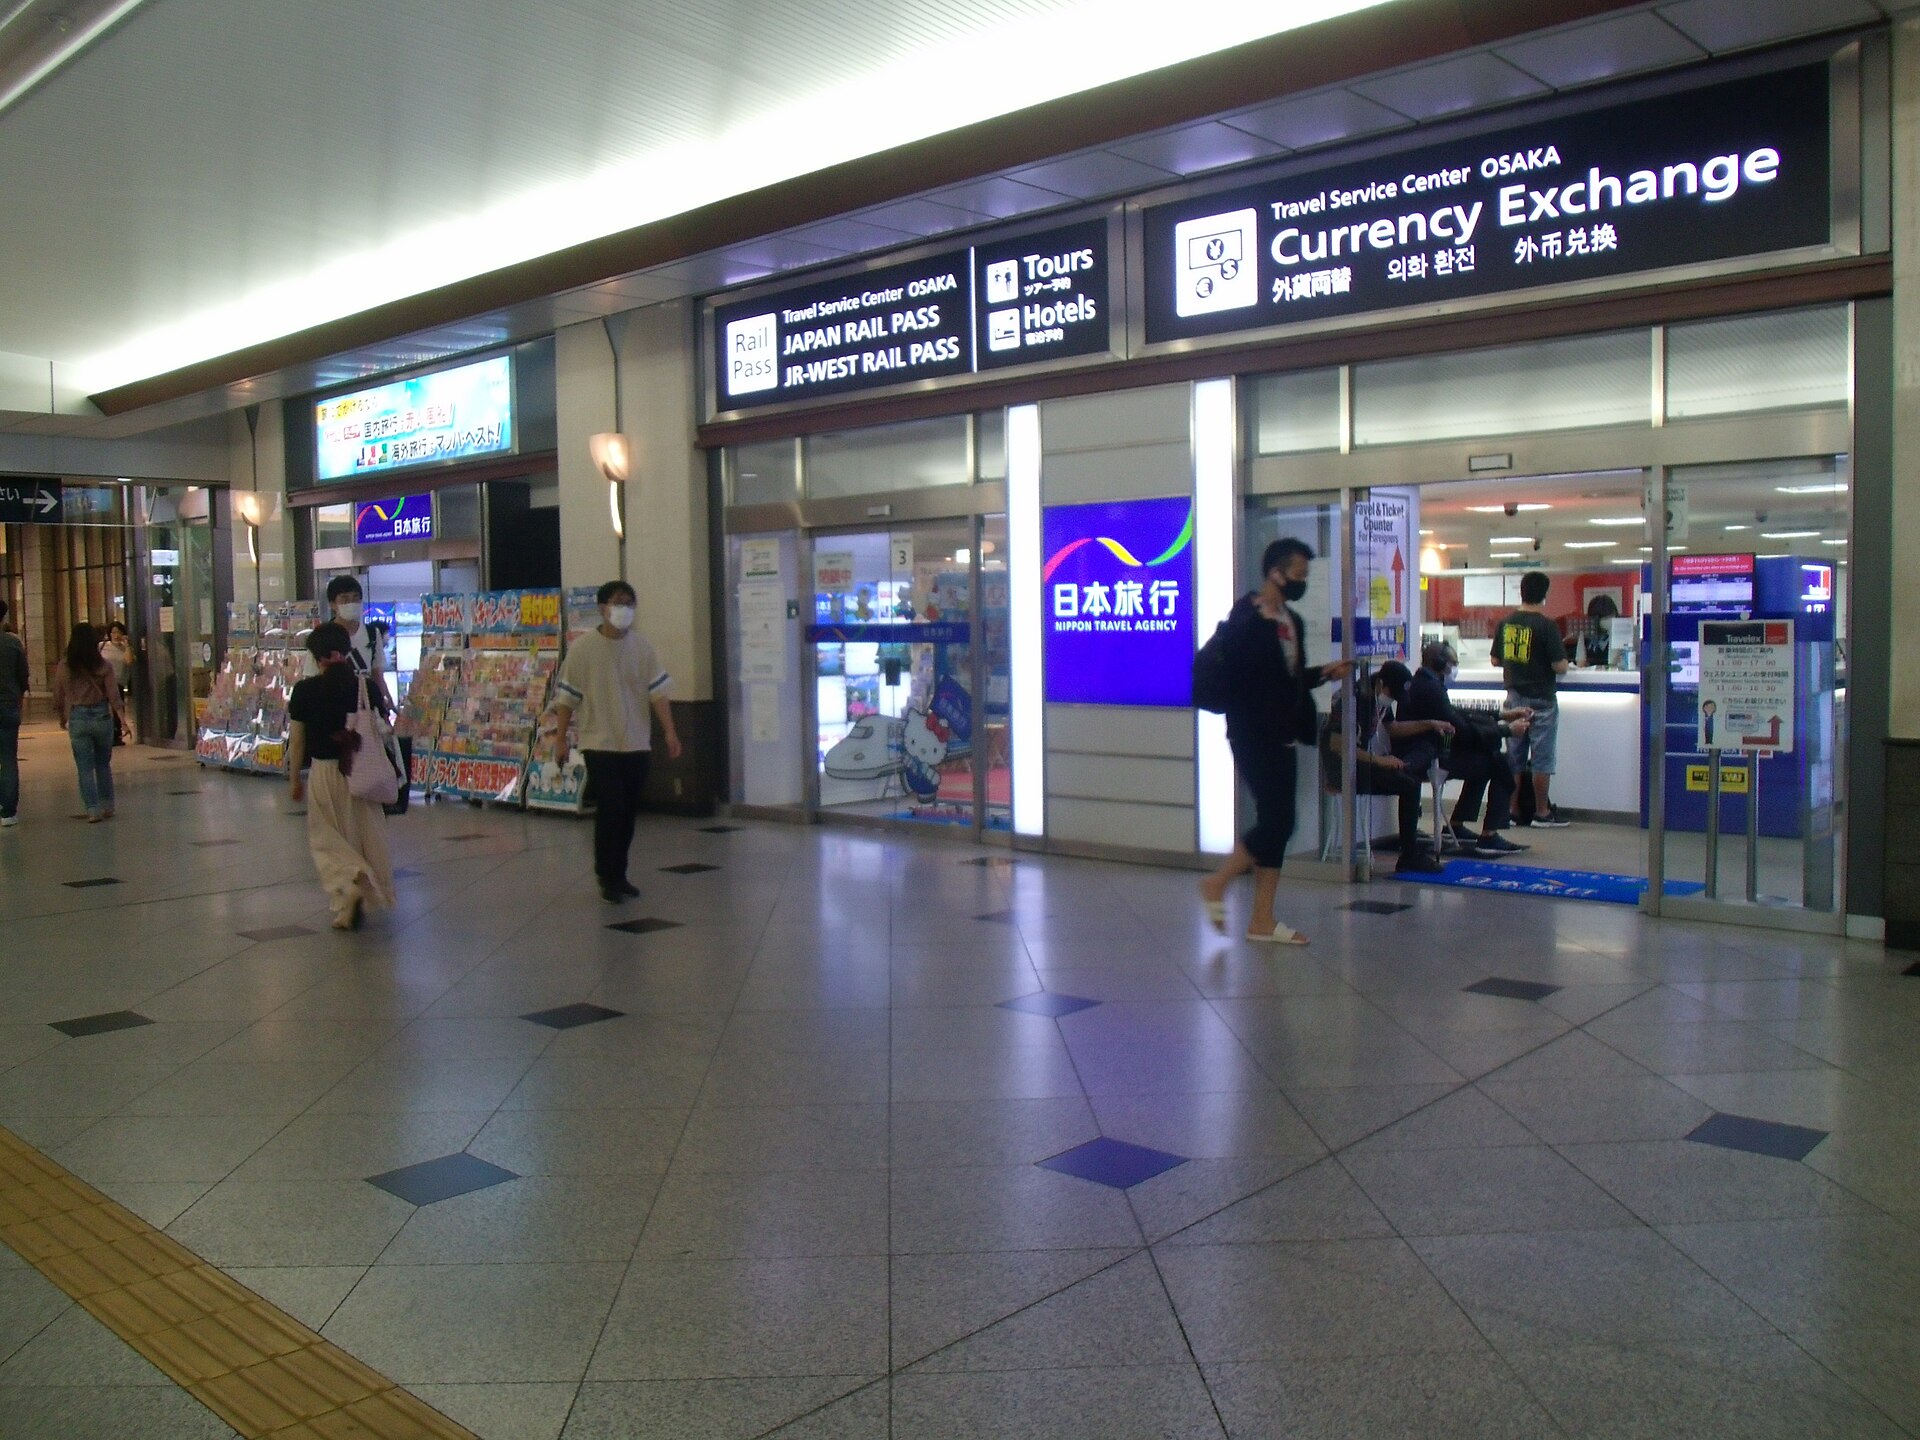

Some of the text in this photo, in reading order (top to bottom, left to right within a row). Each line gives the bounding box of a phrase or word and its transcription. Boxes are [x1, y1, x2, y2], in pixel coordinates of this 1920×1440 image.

[1271, 145, 1561, 220] Travel Service Center OSAKA
[1271, 146, 1780, 265] Currency Exchange
[1514, 223, 1618, 264] 外币兑换
[1023, 248, 1094, 280] Tours
[1387, 244, 1475, 281] 외화 환전
[782, 273, 958, 324] Travel Service Center OSAKA
[1024, 276, 1072, 296] ツアー予約
[1272, 266, 1352, 304] 外貨両替
[1024, 293, 1096, 330] Hotels
[735, 326, 768, 353] Rail
[783, 305, 940, 356] JAPAN RAIL PASS
[734, 358, 771, 379] Pass
[784, 336, 960, 387] JR-WEST RAIL PASS
[394, 516, 431, 536] 日本旅行
[1363, 516, 1393, 532] Counter
[899, 550, 907, 565] 3
[1054, 580, 1179, 617] 日本旅行
[1055, 620, 1177, 631] NIPPON TRAVEL AGENCY
[1727, 634, 1761, 643] Travelex
